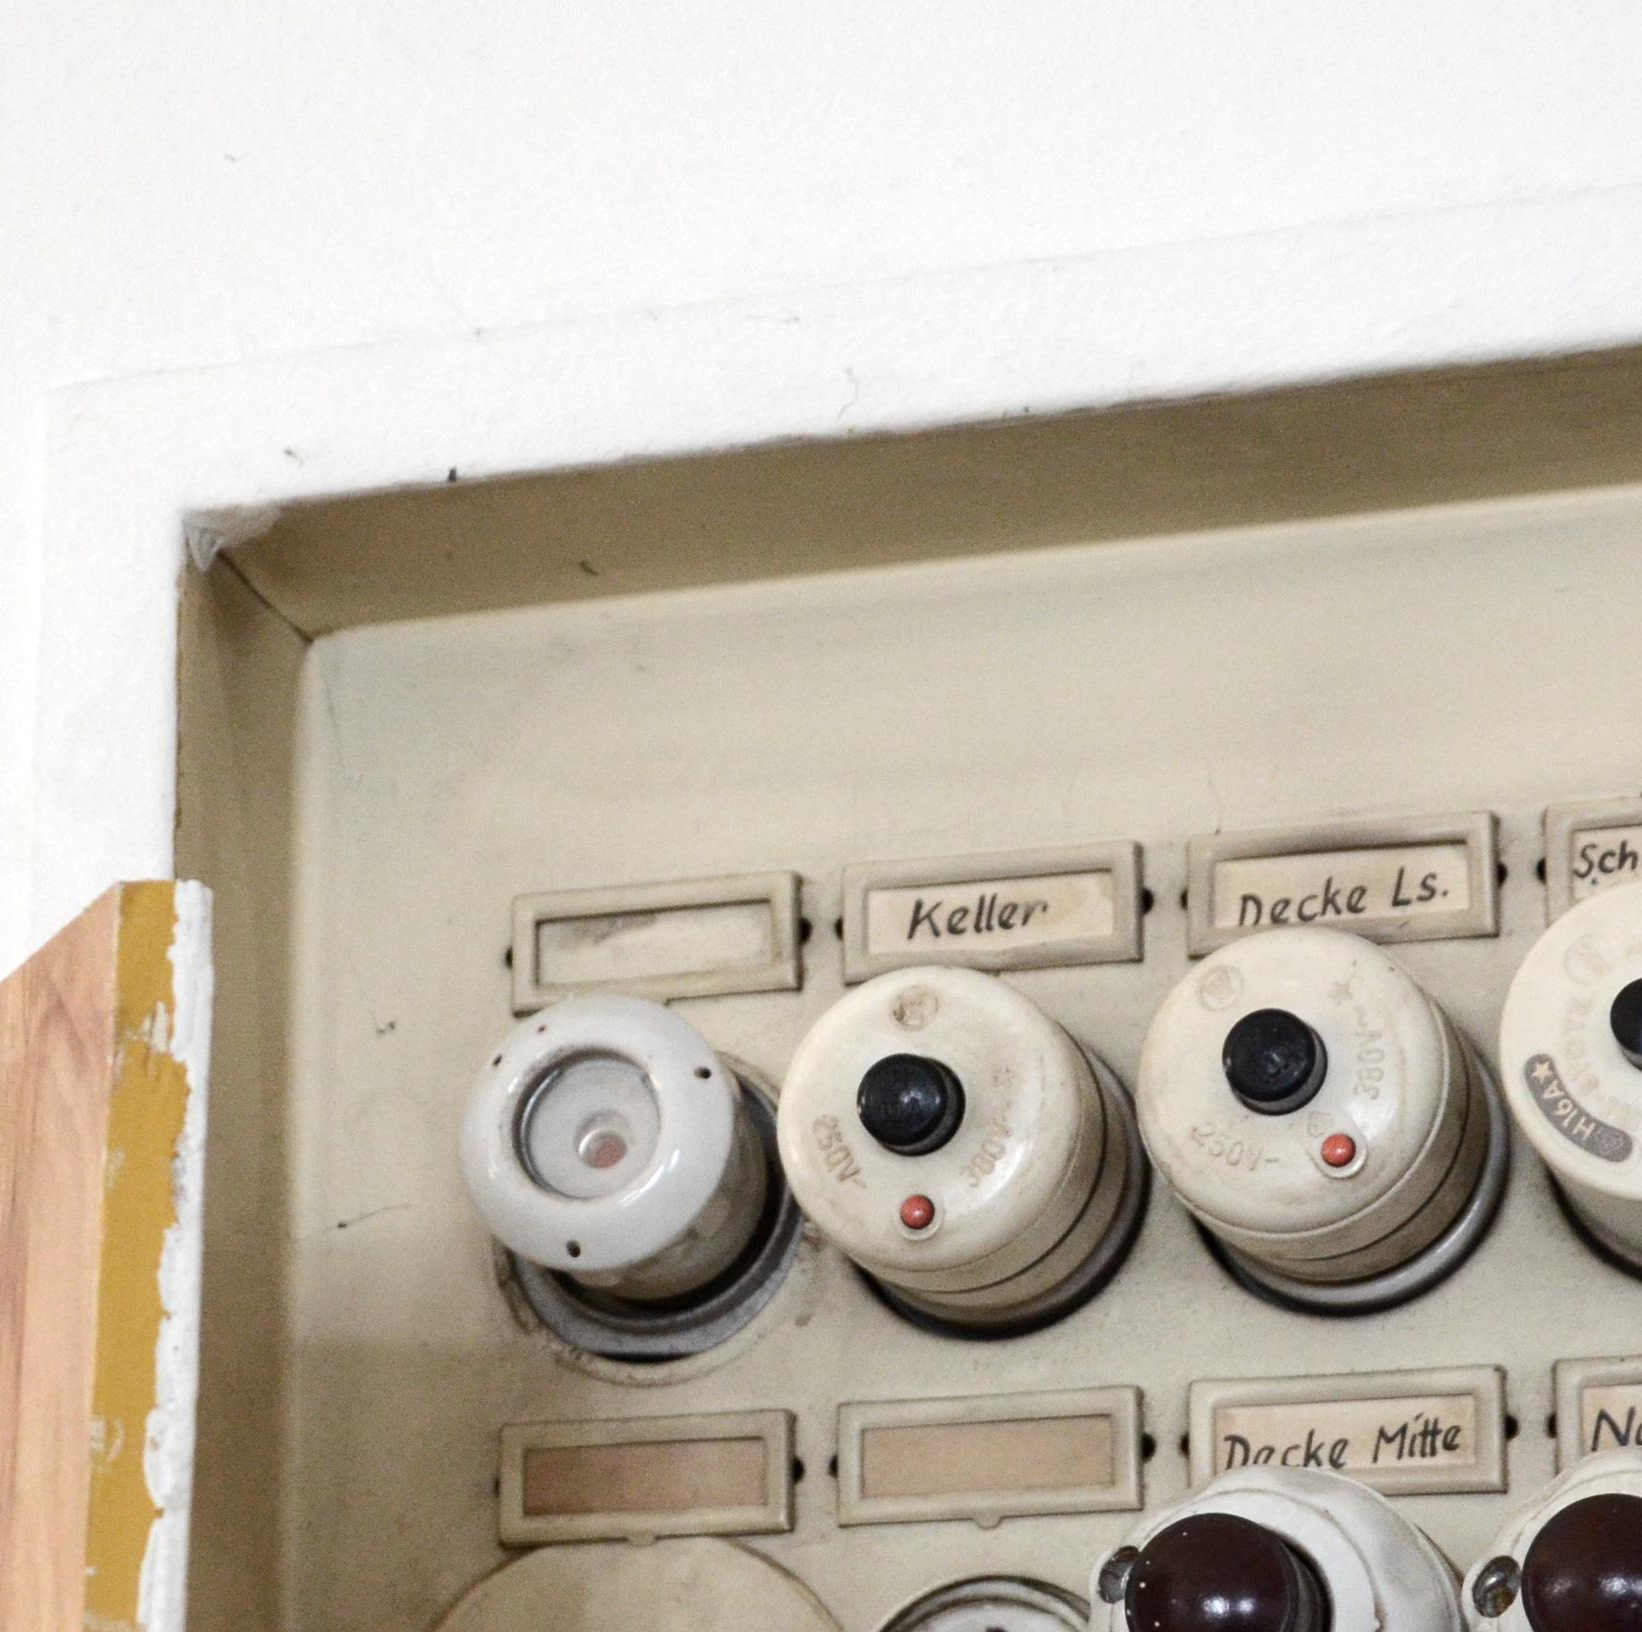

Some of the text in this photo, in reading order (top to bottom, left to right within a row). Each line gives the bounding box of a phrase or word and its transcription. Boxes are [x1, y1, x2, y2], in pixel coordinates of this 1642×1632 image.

[907, 896, 1048, 940] Keller
[1238, 866, 1449, 927] Decke Ls.
[1371, 1412, 1463, 1464] Mitte
